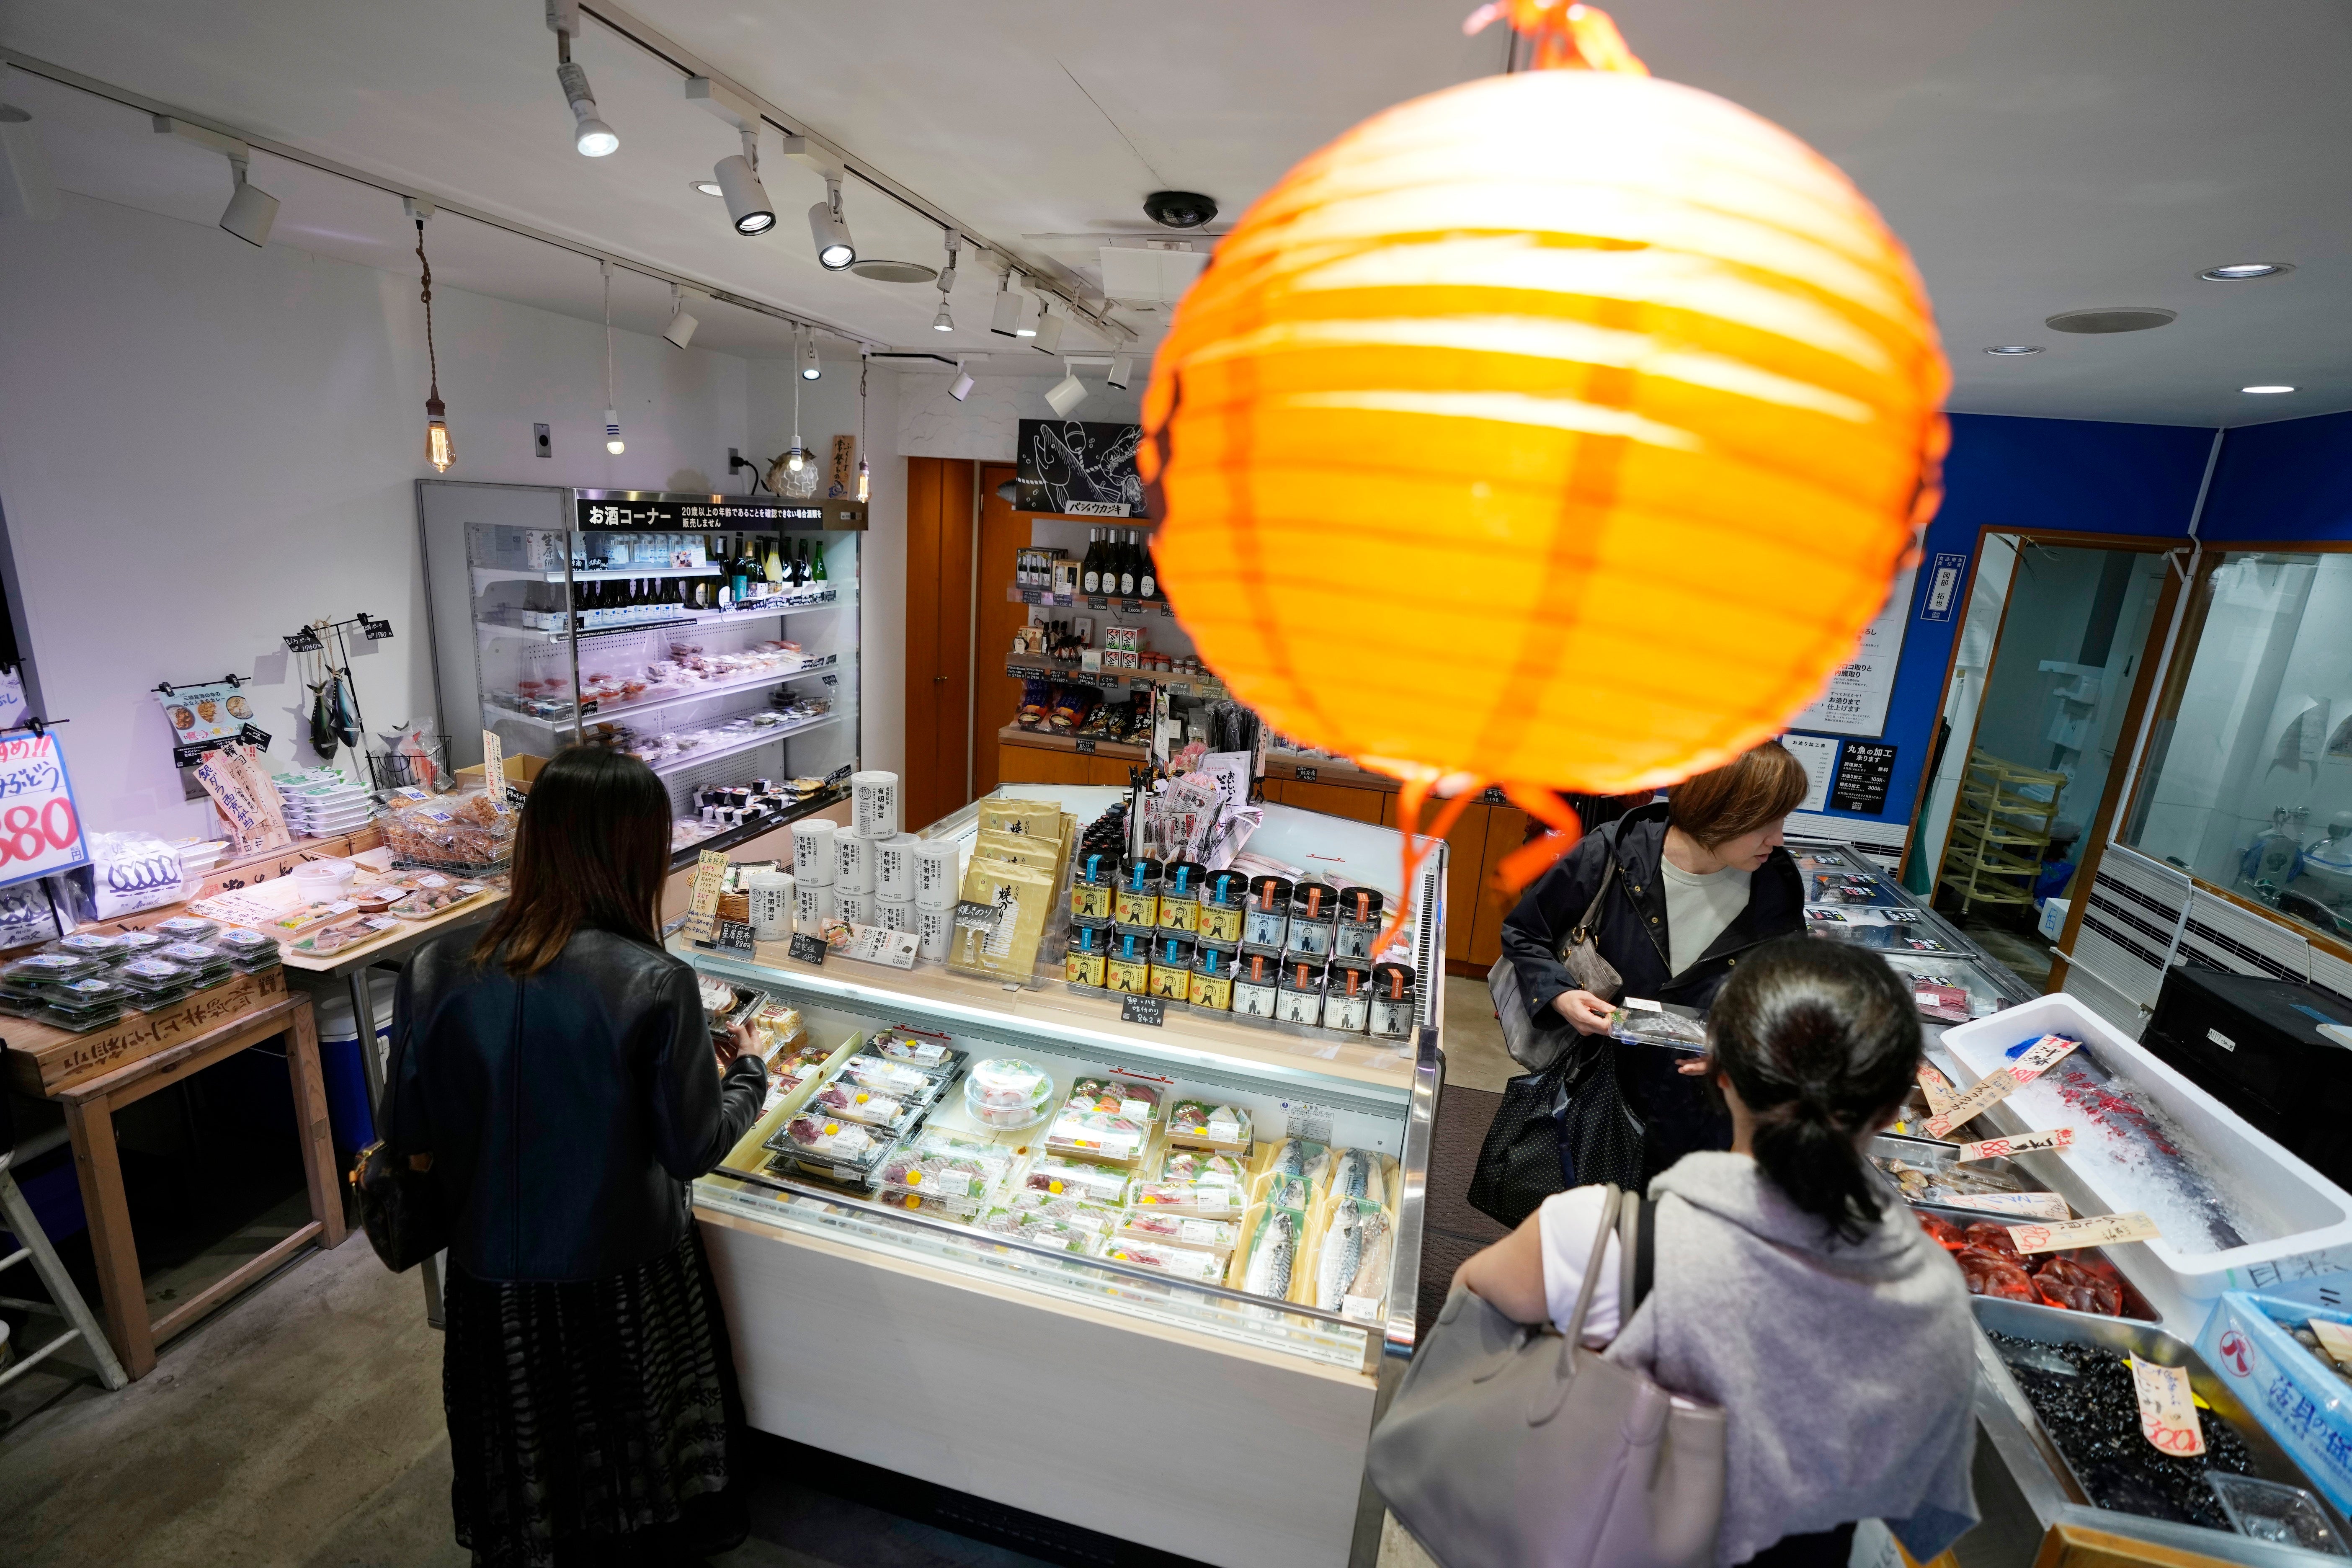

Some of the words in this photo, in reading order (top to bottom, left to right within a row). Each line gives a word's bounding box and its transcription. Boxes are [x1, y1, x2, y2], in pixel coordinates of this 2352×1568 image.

[681, 506, 822, 519] 20歳以上の年齢であることを確認できない場合酒類を
[1069, 502, 1122, 515] バショウカジキ
[590, 505, 671, 526] お酒コーナー
[682, 518, 721, 528] 販売しません
[542, 533, 554, 567] 生原酒
[1941, 572, 1950, 586] 岡部
[1936, 593, 1945, 607] 拓也
[1123, 632, 1131, 650] くさや
[183, 692, 220, 701] 三陸産海の幸の
[183, 697, 225, 707] みなとまちカレー
[1828, 697, 1860, 705] お造りまで
[1827, 704, 1861, 712] 仕上げます
[255, 743, 266, 751] 430円
[1792, 740, 1826, 748] お造り加工表
[1847, 745, 1893, 758] 丸魚の加工
[1227, 771, 1236, 795] おいしい
[198, 764, 255, 830] 銀ダラ西京弁当
[71, 851, 82, 861] 円
[700, 854, 725, 867] 星屑昆布
[702, 871, 724, 880] 炊きたてごはん
[957, 905, 993, 919] 焼きのり
[722, 928, 750, 942] 星屑昆布
[794, 934, 810, 943] 沖縄の
[735, 940, 747, 949] 880
[870, 931, 883, 958] 有明海苔
[802, 953, 816, 963] 680
[1132, 1006, 1159, 1016] 味付のり
[1137, 1014, 1153, 1024] 842
